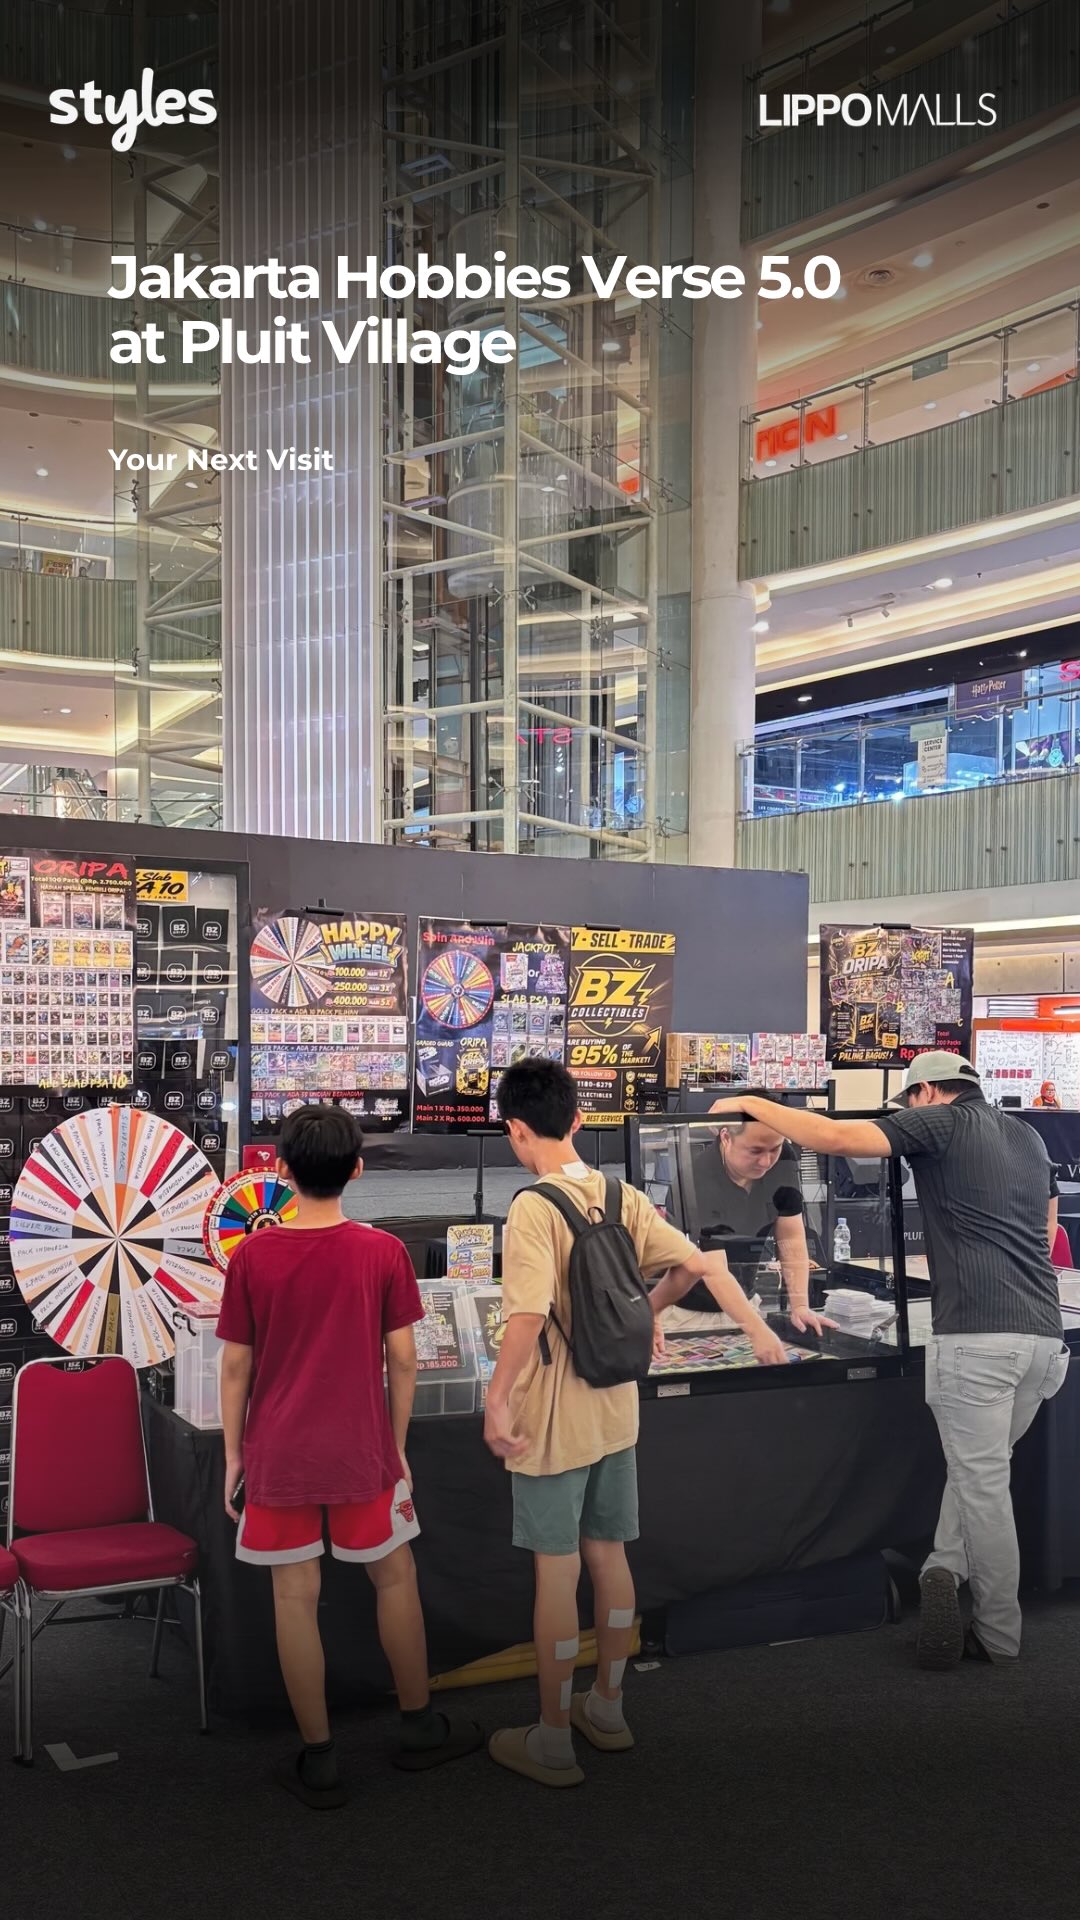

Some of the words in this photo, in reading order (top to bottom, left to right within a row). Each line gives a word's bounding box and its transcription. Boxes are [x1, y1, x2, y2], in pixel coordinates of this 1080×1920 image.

[971, 684, 989, 698] Harry
[989, 680, 1006, 692] Potter
[924, 738, 943, 746] SERVICE
[924, 745, 942, 753] CENTER
[34, 860, 129, 879] ORIPA
[139, 873, 172, 881] Slab
[160, 882, 184, 895] 10
[321, 920, 401, 945] HAPPY
[423, 932, 448, 943] Spin
[513, 942, 556, 953] JACKPOT
[591, 933, 618, 948] SELL
[629, 934, 666, 949] TRADE
[853, 942, 879, 957] BZ
[335, 967, 365, 977] 100.000
[843, 956, 888, 975] ORIPA
[528, 969, 540, 978] Or
[945, 972, 955, 989] A
[571, 970, 648, 1006] BZ
[501, 994, 525, 1004] SLAB
[529, 994, 548, 1005] PSA
[551, 996, 560, 1006] 10
[571, 1007, 645, 1018] COLLECTIBLES
[460, 1037, 487, 1047] ORIPA
[570, 1044, 618, 1065] 95%
[620, 1056, 651, 1064] MARKET!
[838, 1051, 863, 1060] PALING
[865, 1051, 889, 1060] BAGUS!
[900, 1048, 915, 1060] Rp
[120, 1114, 129, 1148] SILVER
[118, 1151, 126, 1171] PACK
[184, 1161, 199, 1176] PACK
[14, 1217, 40, 1229] SILVER
[43, 1224, 60, 1233] PACK
